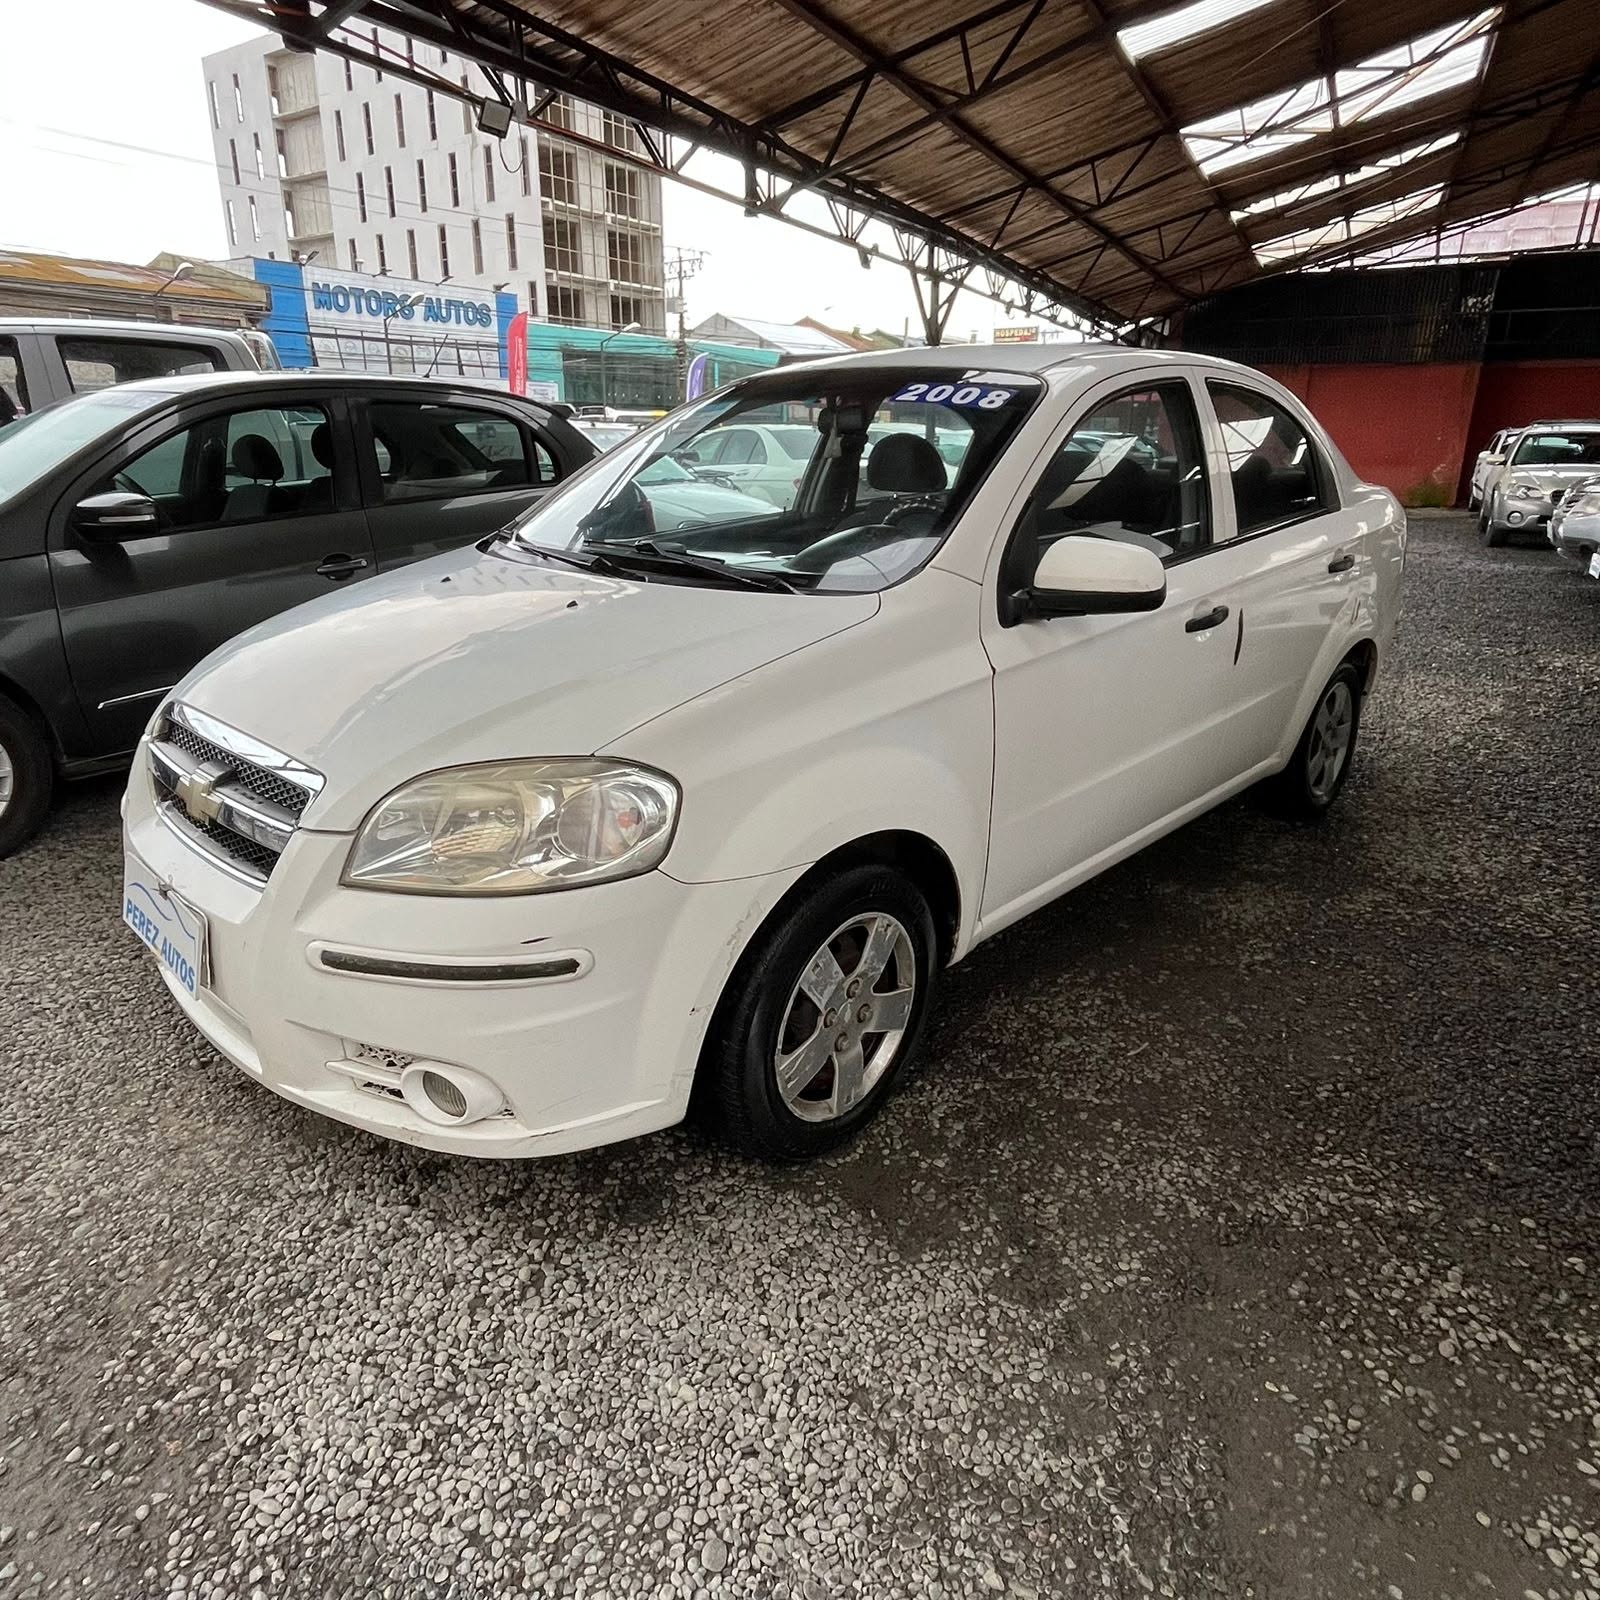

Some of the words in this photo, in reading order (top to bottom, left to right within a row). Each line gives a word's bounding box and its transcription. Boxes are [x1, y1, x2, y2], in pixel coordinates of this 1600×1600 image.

[312, 282, 415, 320] MOTORS
[423, 297, 492, 328] AUTOS
[895, 384, 1011, 408] 2008
[126, 898, 160, 945] PEREZ
[160, 936, 195, 992] AUTOS
